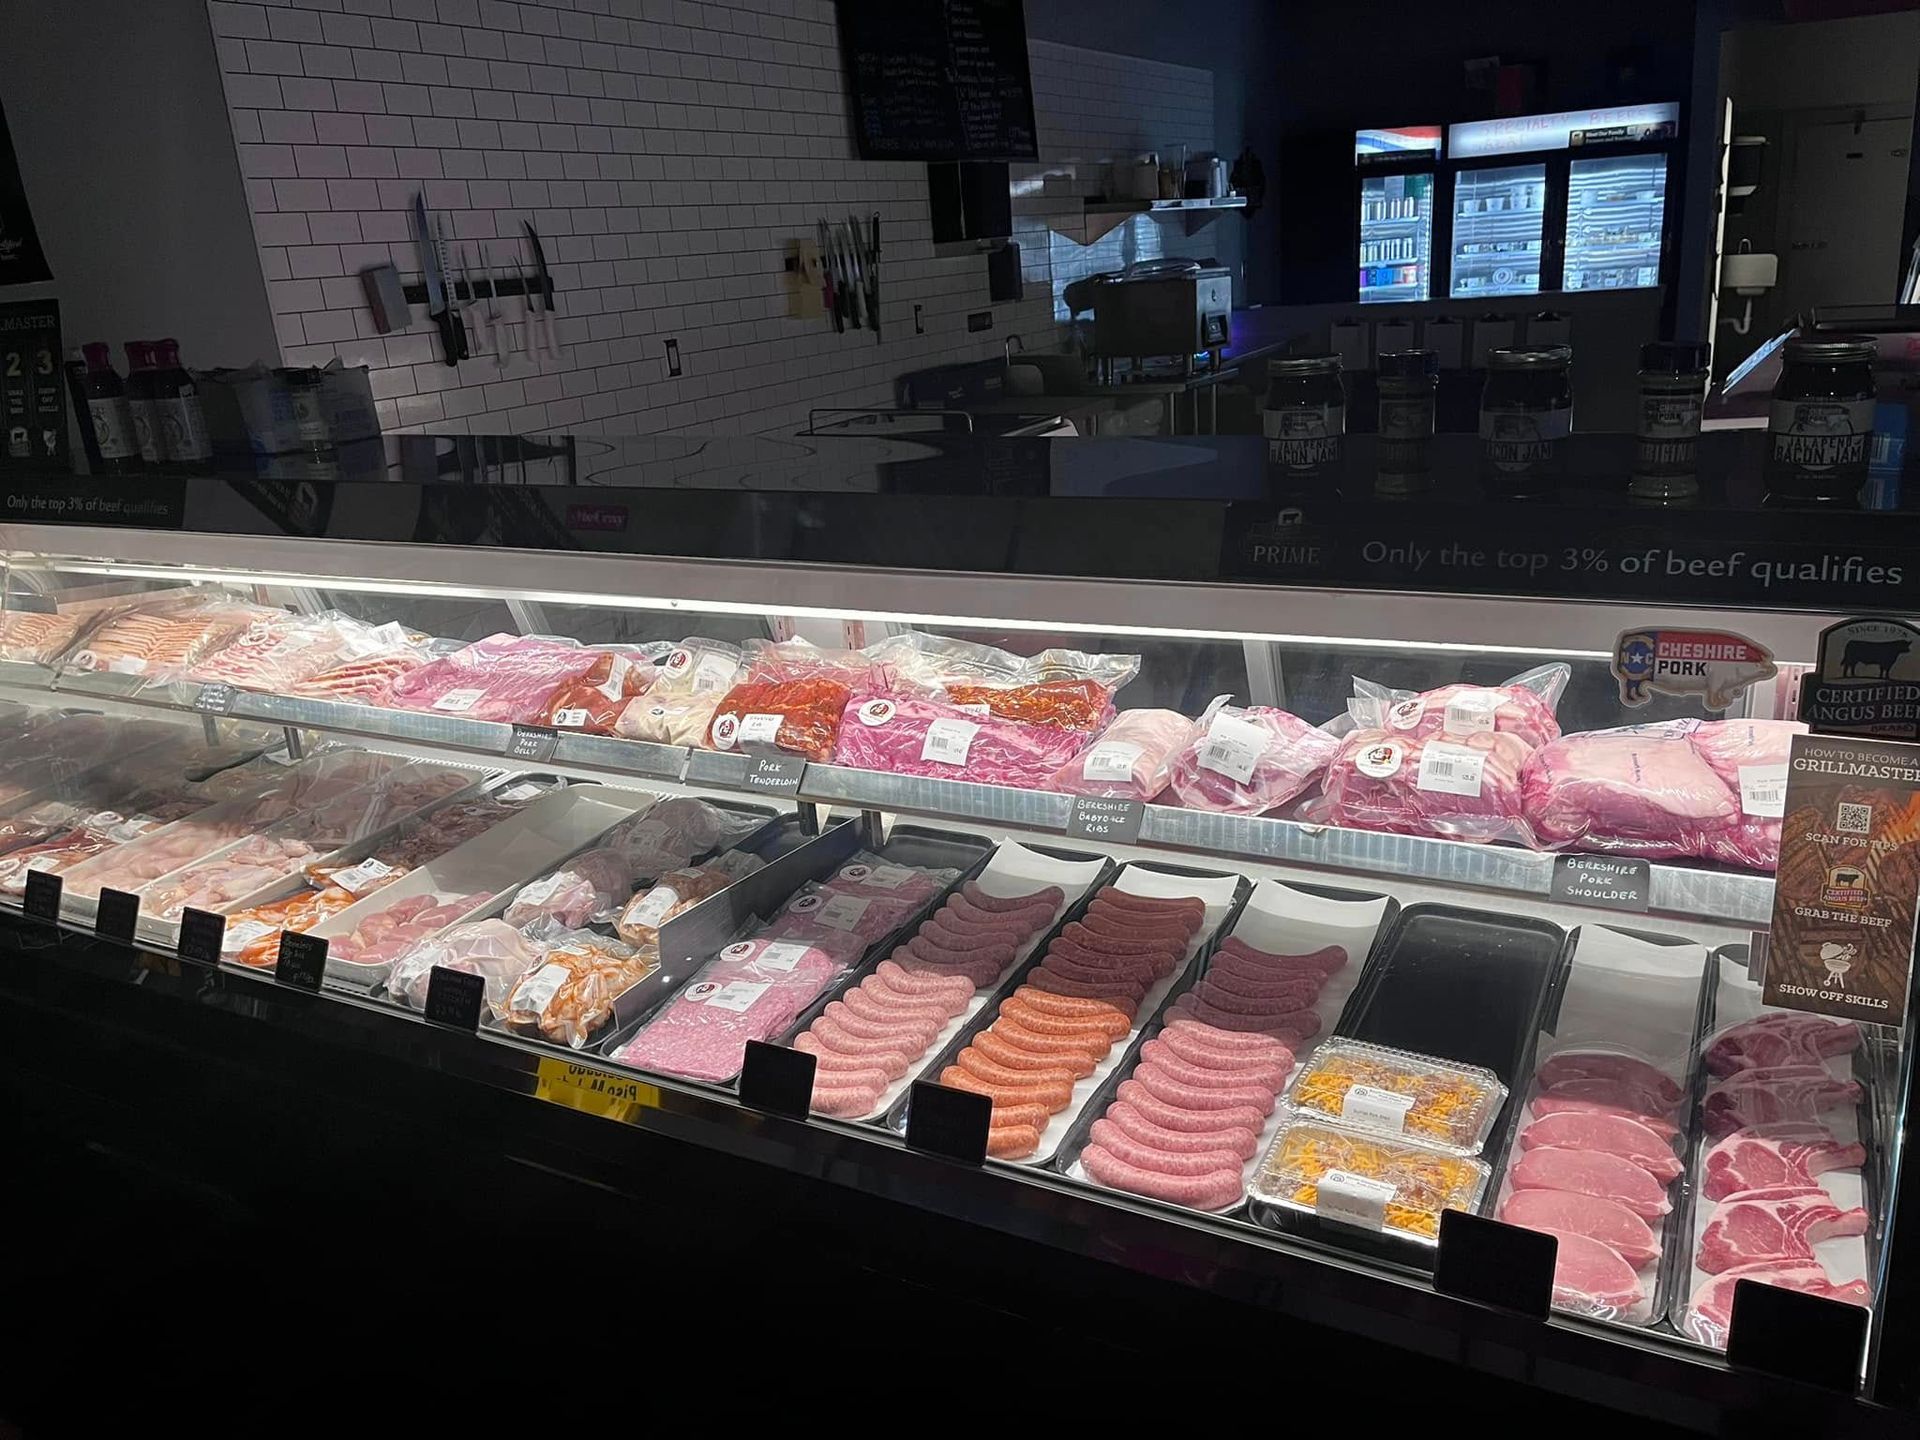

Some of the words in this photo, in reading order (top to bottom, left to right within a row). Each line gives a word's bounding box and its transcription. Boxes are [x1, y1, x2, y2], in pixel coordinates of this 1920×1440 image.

[6, 352, 22, 377] 2
[37, 350, 54, 375] 3
[1312, 447, 1338, 464] JAM
[1774, 446, 1825, 464] BACON
[1830, 446, 1864, 464] JAM
[7, 494, 29, 512] Only
[31, 496, 47, 510] the
[49, 497, 66, 514] top
[66, 498, 84, 511] 3%
[85, 498, 98, 511] of
[99, 499, 121, 512] beef
[1253, 545, 1320, 564] PRIME
[1362, 540, 1432, 573] Only
[1440, 541, 1486, 567] the
[1497, 549, 1549, 577] top
[1560, 547, 1608, 573] 3%
[1620, 549, 1661, 574] of
[1665, 549, 1746, 577] beef
[1751, 555, 1903, 587] qualifies
[1848, 624, 1880, 634] SINCE
[1658, 641, 1747, 661] CHESHIRE
[1657, 661, 1707, 676] PORK
[1816, 686, 1920, 704] CERTIFIED
[1806, 704, 1876, 721] ANGUS
[1804, 748, 1837, 758] HOW
[1838, 750, 1855, 761] TO
[1857, 752, 1909, 766] BECOME
[1910, 757, 1919, 767] A
[749, 774, 800, 787] TENDERLOIN
[1077, 799, 1130, 813] BERKSHIRE
[1085, 823, 1109, 834] RIBS
[1804, 832, 1840, 846] SCAN
[1841, 836, 1868, 848] FOR
[1870, 838, 1898, 852] TIPS
[1566, 857, 1639, 876] BERKSHIRE
[1580, 872, 1613, 885] PORK
[1566, 886, 1638, 901] SHOULDER
[1795, 906, 1831, 921] GRAB
[1832, 910, 1858, 924] THE
[1859, 912, 1893, 928] BEEF
[1779, 983, 1819, 997] SHOW
[1820, 988, 1846, 1002] OFF
[1846, 993, 1889, 1009] SKILLS
